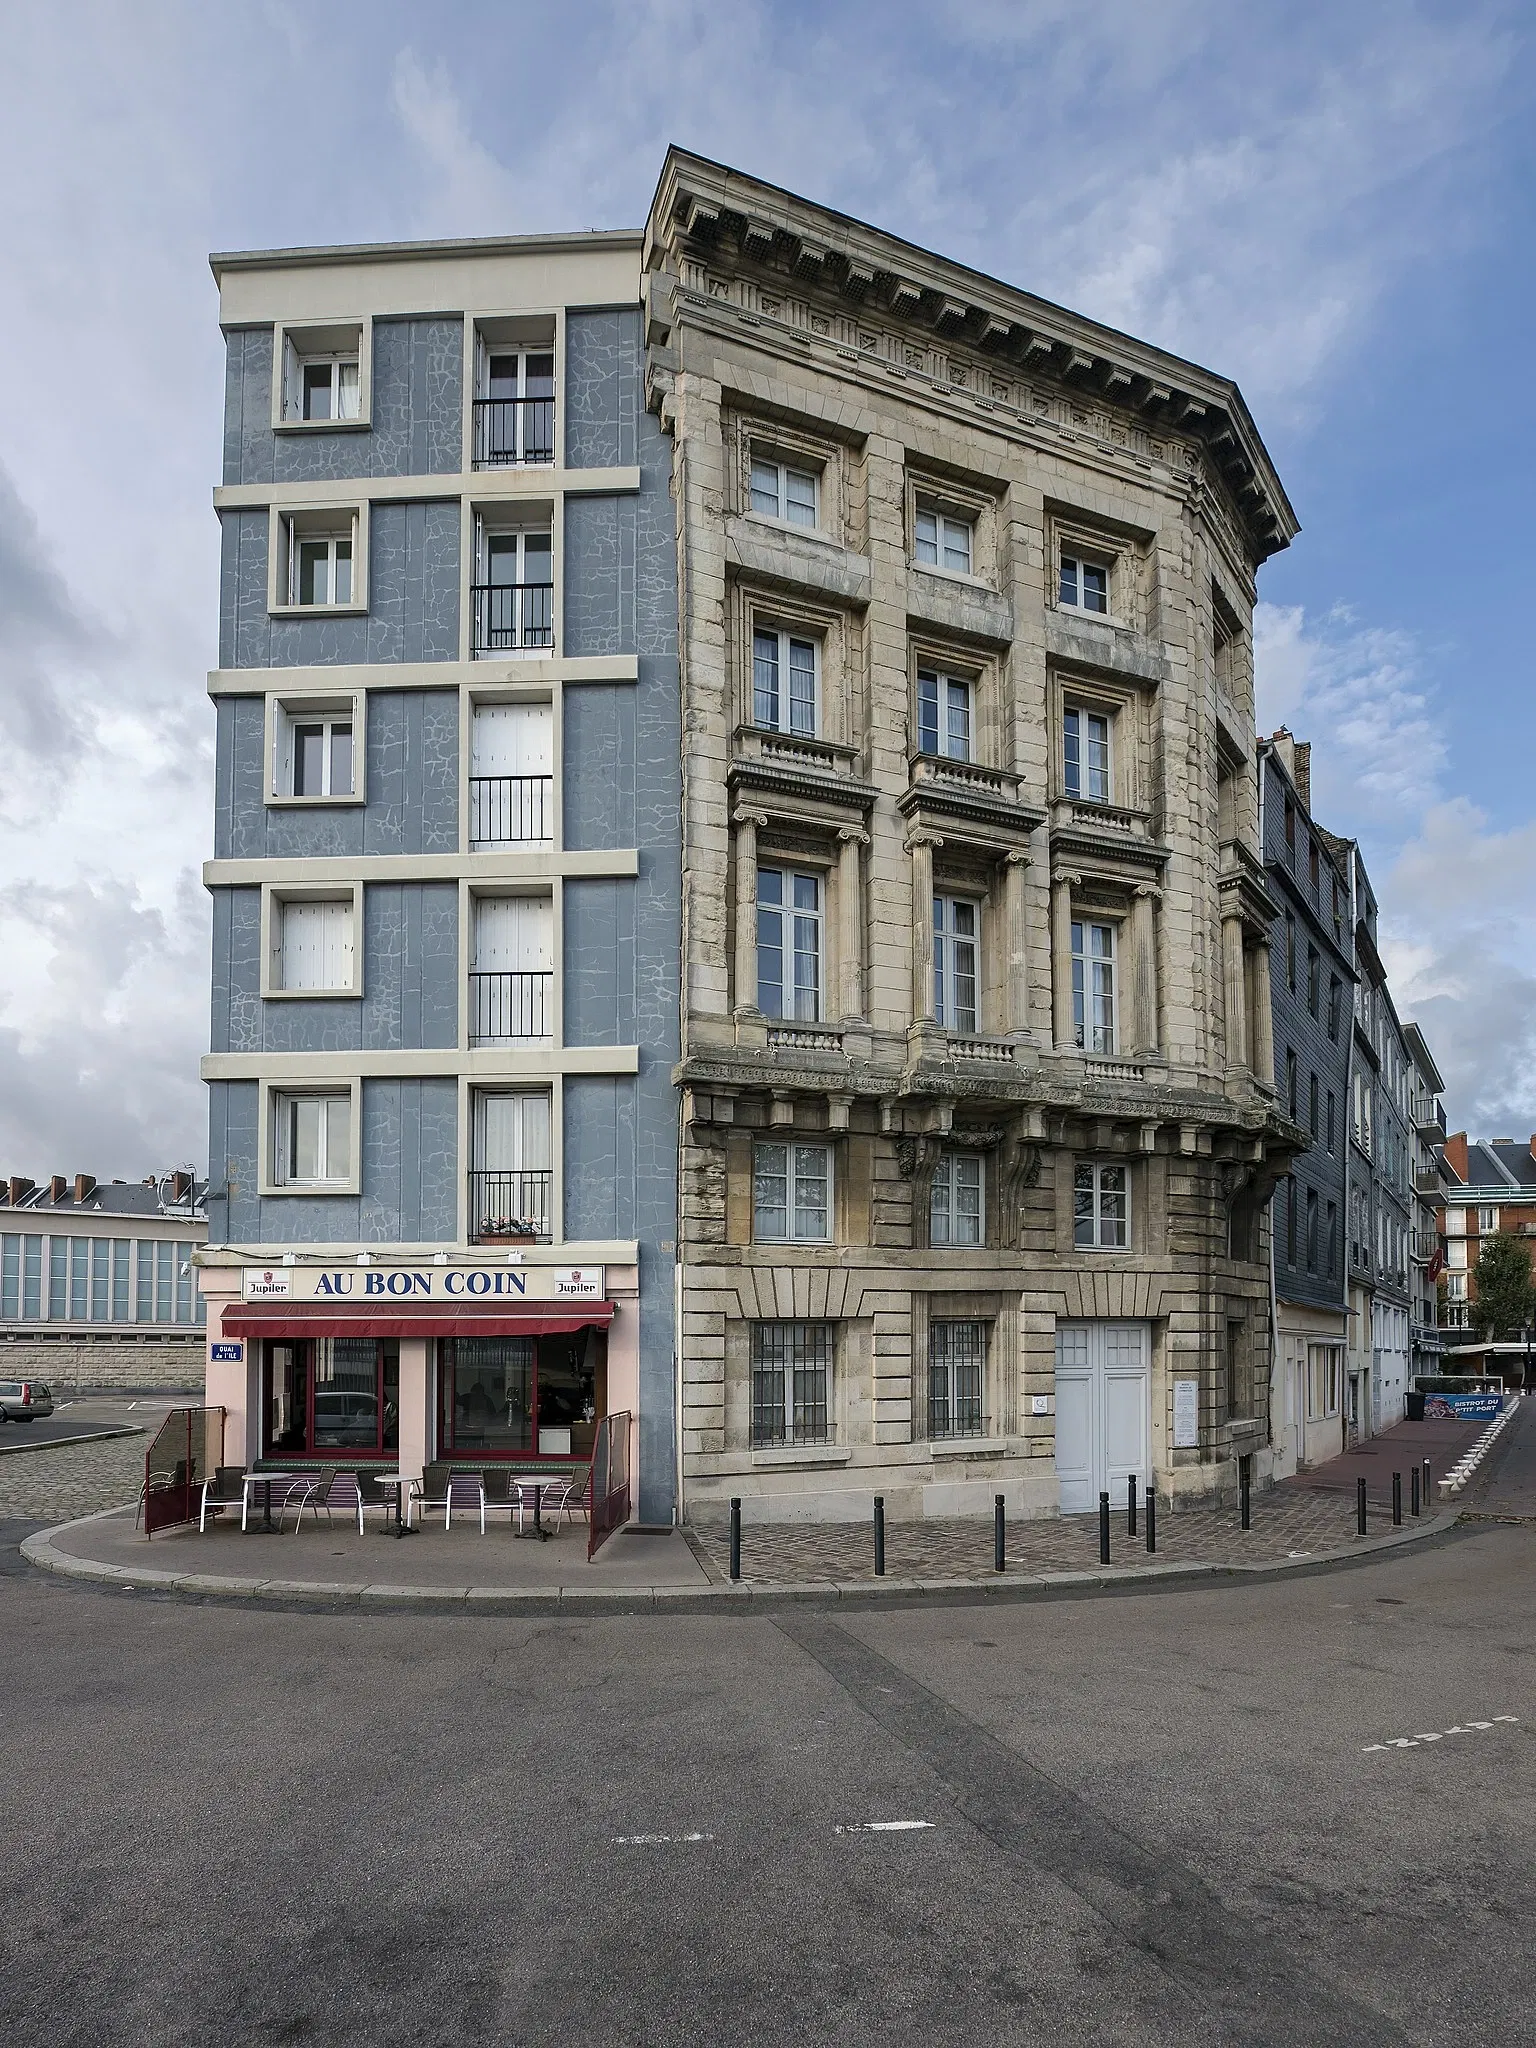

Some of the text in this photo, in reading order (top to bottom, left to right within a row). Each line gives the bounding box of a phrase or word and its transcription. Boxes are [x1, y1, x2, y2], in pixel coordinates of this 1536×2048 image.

[250, 1283, 287, 1294] Jupiler
[313, 1272, 528, 1295] AU BON COIN
[557, 1283, 596, 1294] Jupiler
